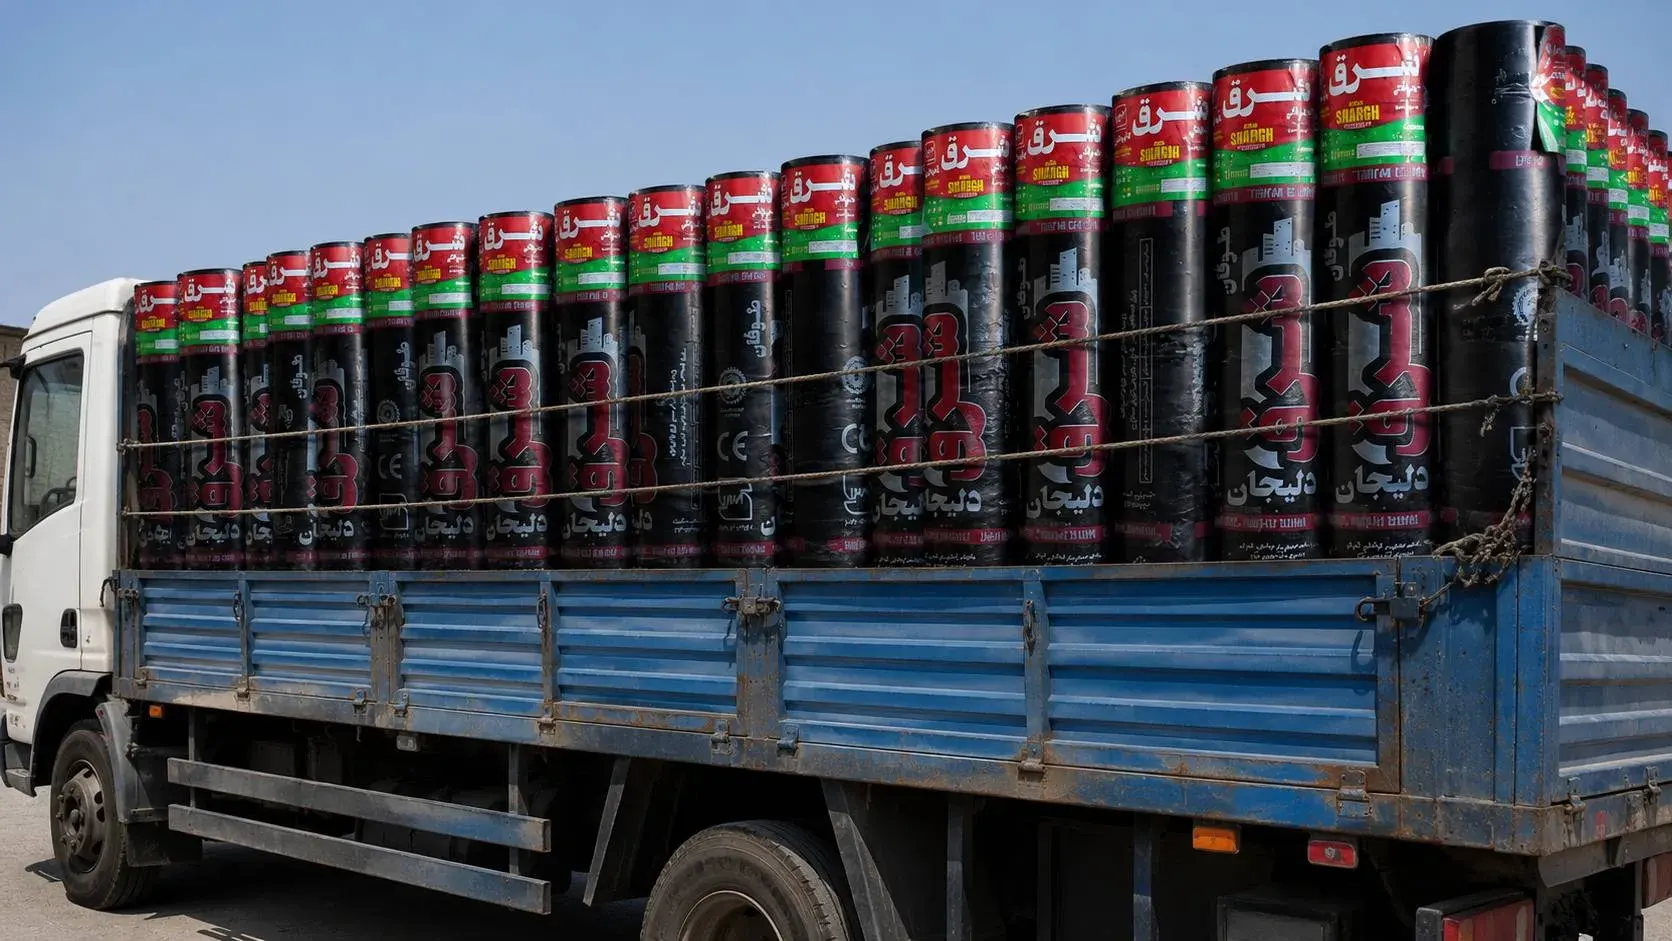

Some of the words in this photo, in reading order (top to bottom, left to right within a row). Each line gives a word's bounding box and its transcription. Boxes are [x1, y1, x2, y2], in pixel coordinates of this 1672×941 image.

[1328, 50, 1421, 97] شرق
[1222, 78, 1311, 119] شرق
[1335, 104, 1380, 125] SHARGH
[1131, 96, 1209, 137] شرق
[940, 135, 1010, 171] شرق
[1027, 119, 1102, 156] شرق
[789, 167, 856, 204] شرق
[879, 154, 923, 189] رق
[638, 196, 702, 228] شرق
[710, 184, 773, 217] شرق
[484, 220, 544, 251] شرق
[559, 208, 621, 240] شرق
[371, 243, 413, 270] رق
[414, 231, 466, 262] شرق
[312, 250, 361, 279] شرق
[184, 274, 236, 302] شرق
[716, 430, 749, 462] CE
[1226, 468, 1317, 506] دلیجان
[1335, 463, 1429, 504] دلیجان
[872, 492, 923, 524] لیجا
[924, 487, 982, 518] دلیجا
[1025, 483, 1105, 519] دلیجان
[486, 512, 548, 541] دلیجان
